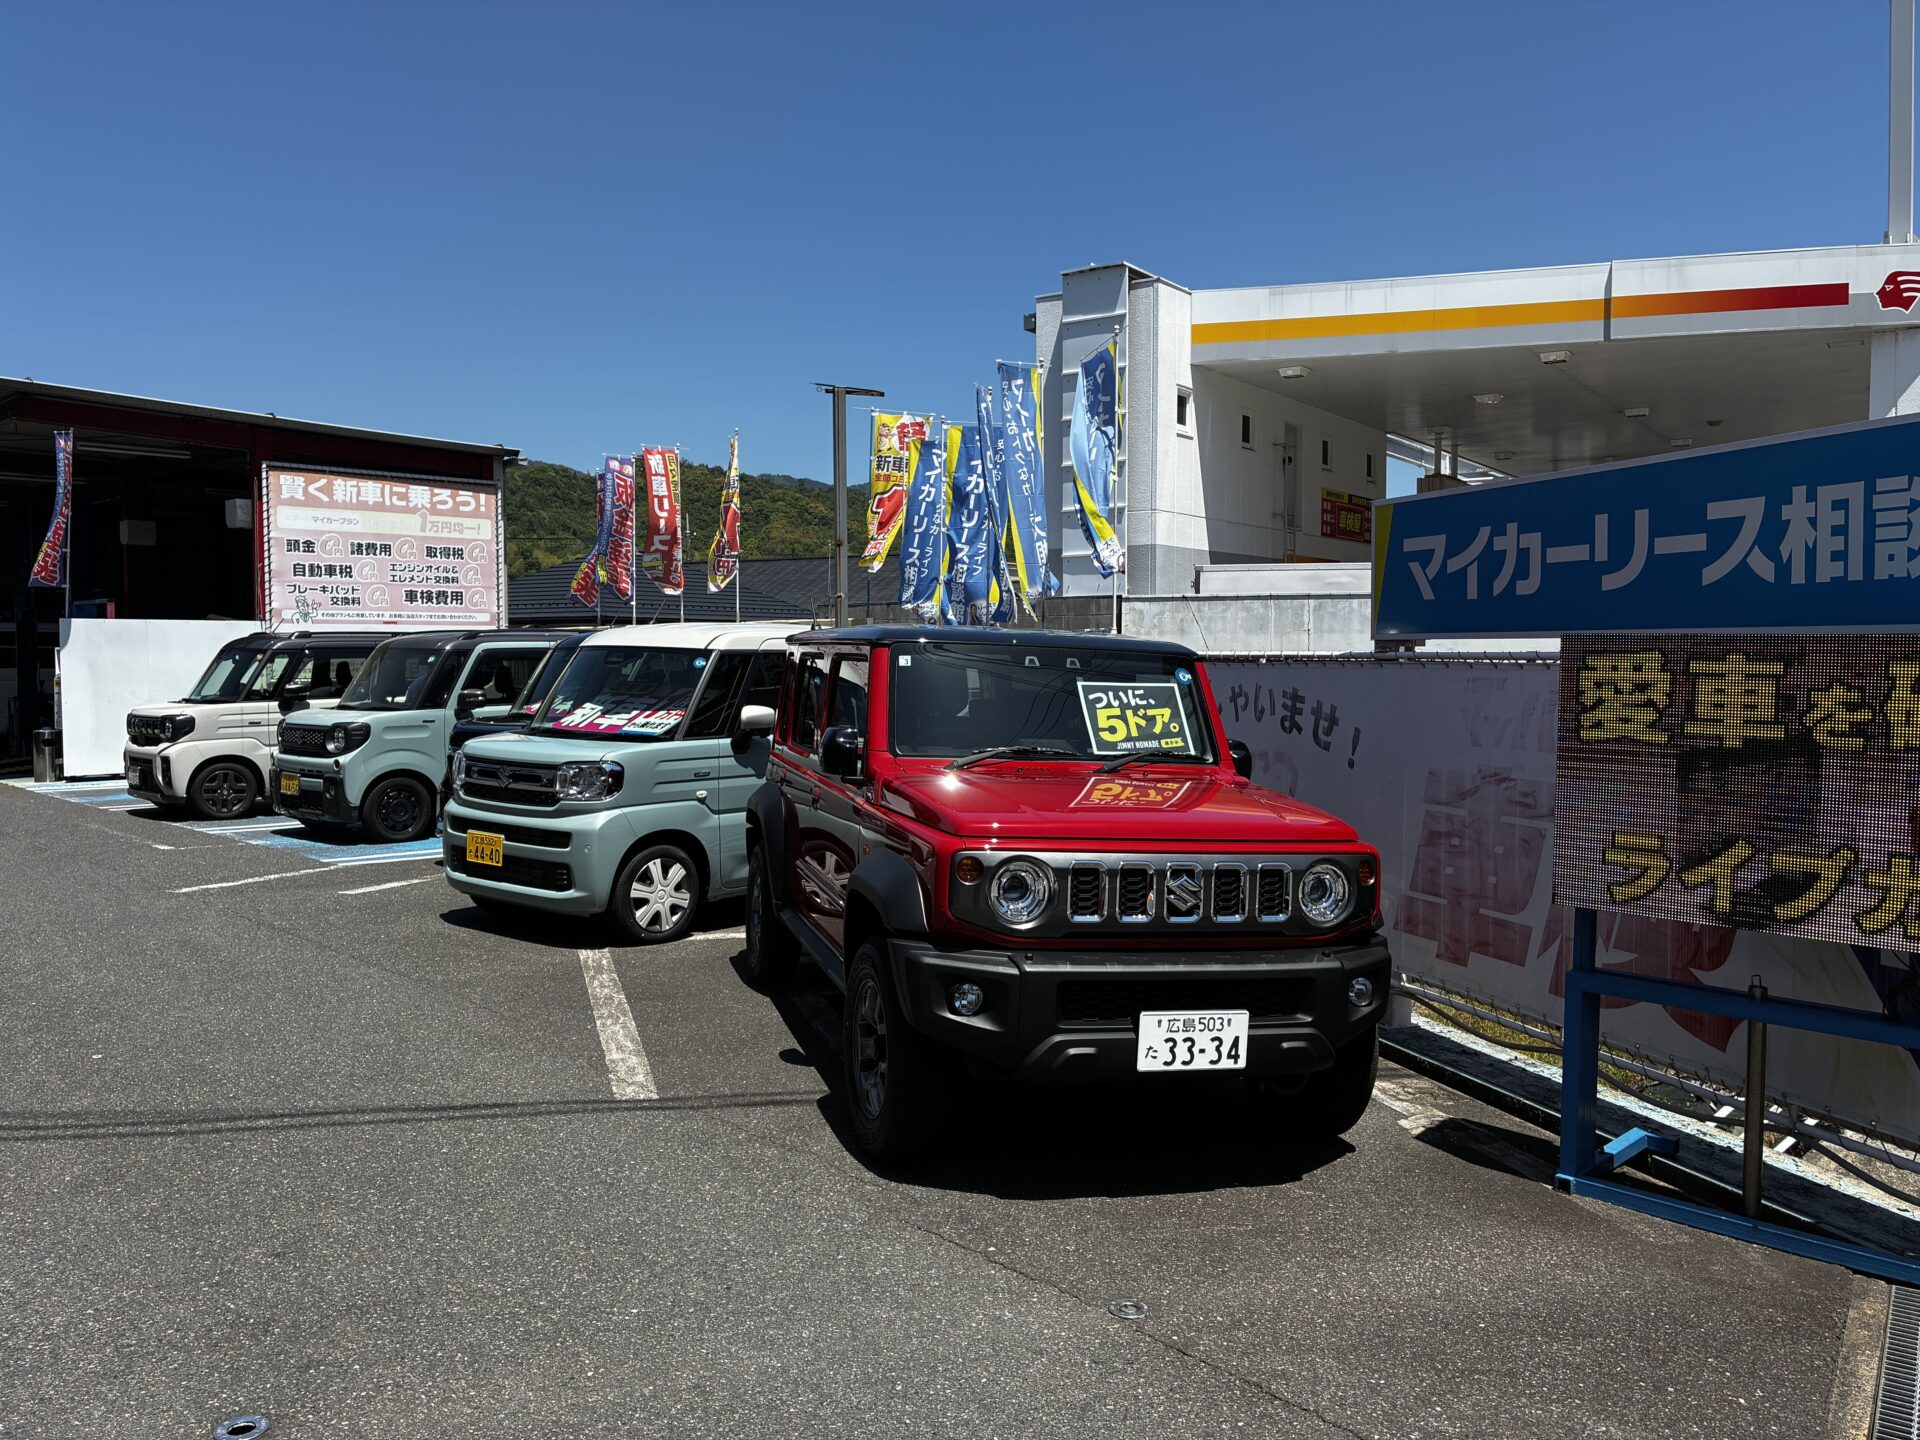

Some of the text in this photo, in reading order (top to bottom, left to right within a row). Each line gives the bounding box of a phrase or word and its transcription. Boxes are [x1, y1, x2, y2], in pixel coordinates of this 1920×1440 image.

[876, 454, 908, 474] 新車
[279, 475, 486, 512] 賢く新車に乗ろう！
[311, 515, 360, 526] マイカープラン
[285, 539, 316, 554] 頭金
[350, 541, 392, 557] 諸費用
[425, 545, 465, 561] 取得税
[292, 562, 354, 579] 自動車税
[389, 563, 459, 574] エンジンオイル&
[389, 574, 460, 585] エレメント交換料
[286, 584, 361, 596] ブレーキパッド
[403, 589, 464, 606] 車検費用
[329, 596, 362, 607] 交換料
[1087, 689, 1156, 709] ついに、
[1096, 707, 1180, 742] 5ドア。
[1117, 741, 1135, 750] JIMNY
[1135, 740, 1161, 749] NOMADE
[1166, 1016, 1226, 1033] 広島503
[1144, 1035, 1241, 1067] た 33-34
